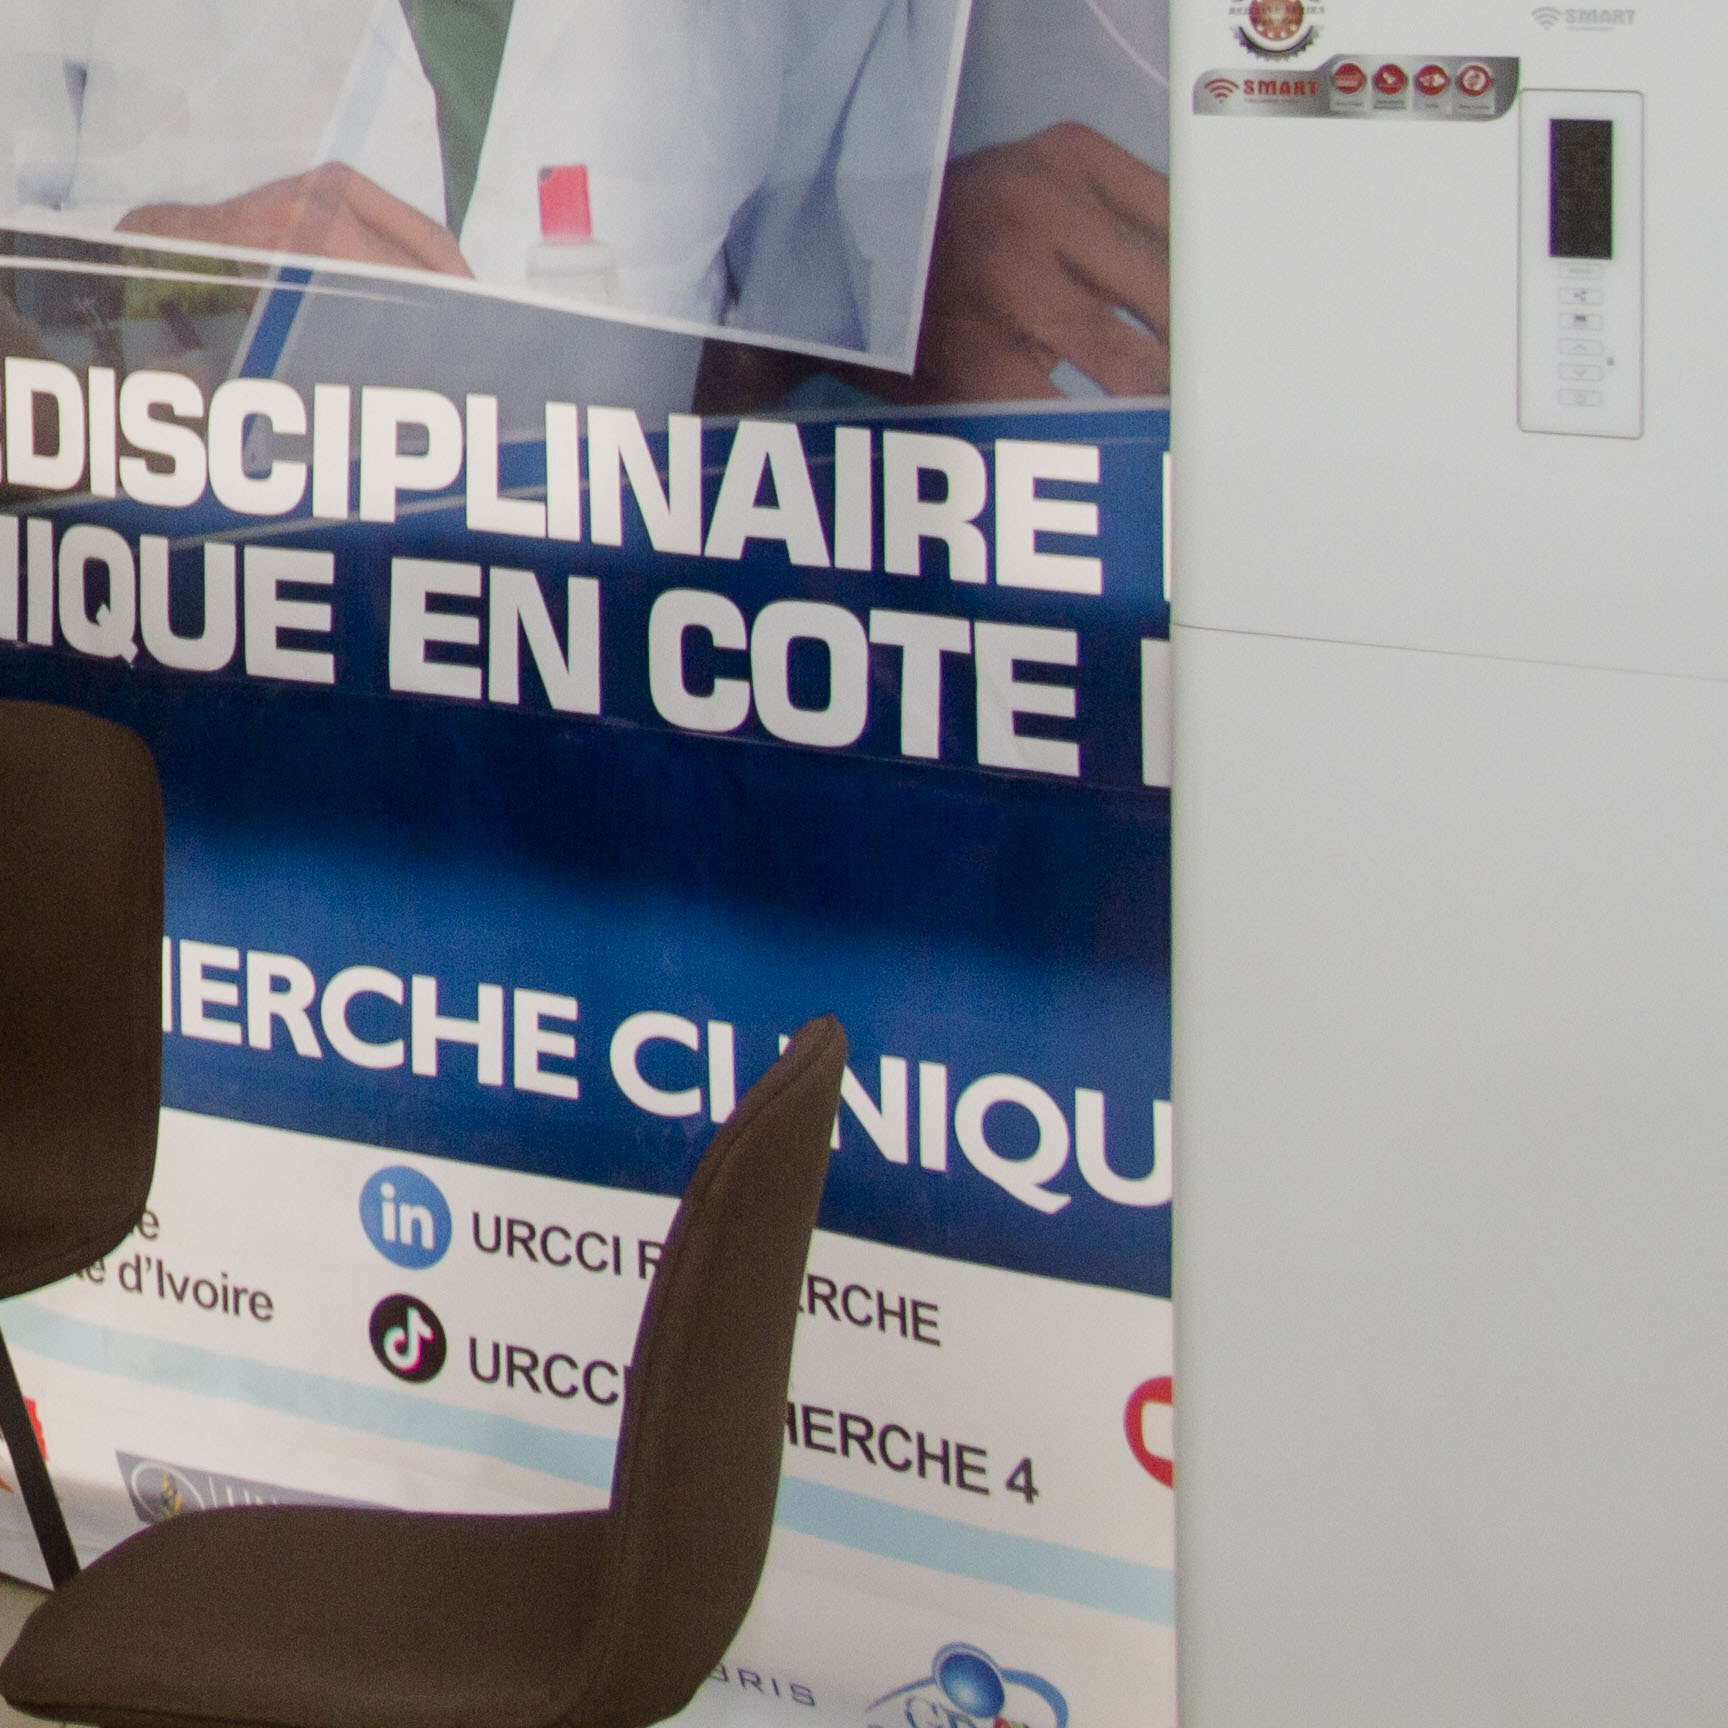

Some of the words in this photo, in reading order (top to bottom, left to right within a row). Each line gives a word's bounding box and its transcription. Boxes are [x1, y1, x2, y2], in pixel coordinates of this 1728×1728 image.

[1242, 78, 1321, 97] SMART
[389, 557, 601, 716] EN
[648, 586, 1081, 778] COTE
[162, 935, 580, 1101] ERCHE
[471, 1210, 622, 1277] URCCI
[117, 1251, 274, 1322] d'Ivoire
[1004, 1456, 1040, 1505] 4
